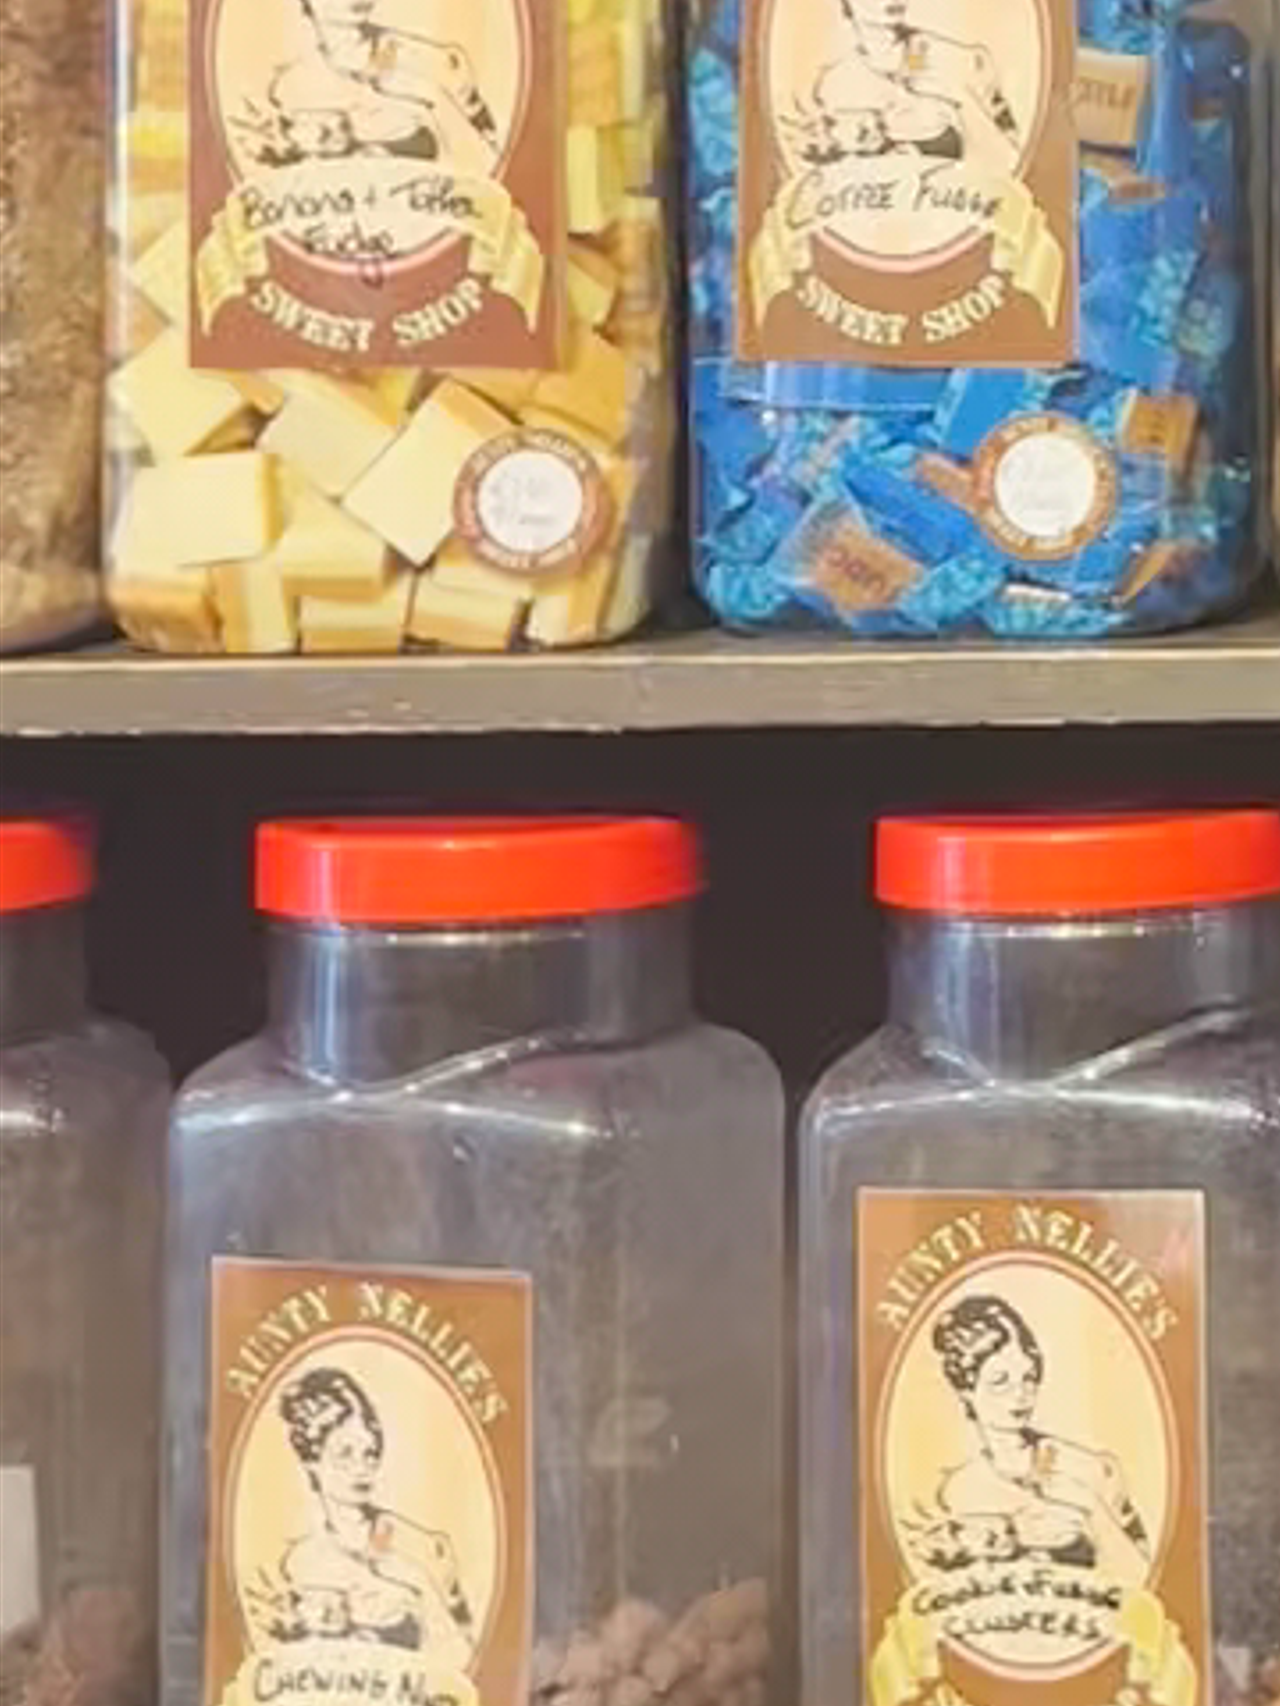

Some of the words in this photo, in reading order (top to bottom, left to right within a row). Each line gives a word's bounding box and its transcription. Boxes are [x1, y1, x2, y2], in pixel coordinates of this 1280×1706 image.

[251, 283, 371, 350] SWEET
[394, 281, 483, 345] SHOP
[800, 277, 907, 345] SWEET
[923, 274, 1007, 343] SHOP
[878, 1211, 988, 1334] AUNTY
[227, 1288, 332, 1399] AUNTY
